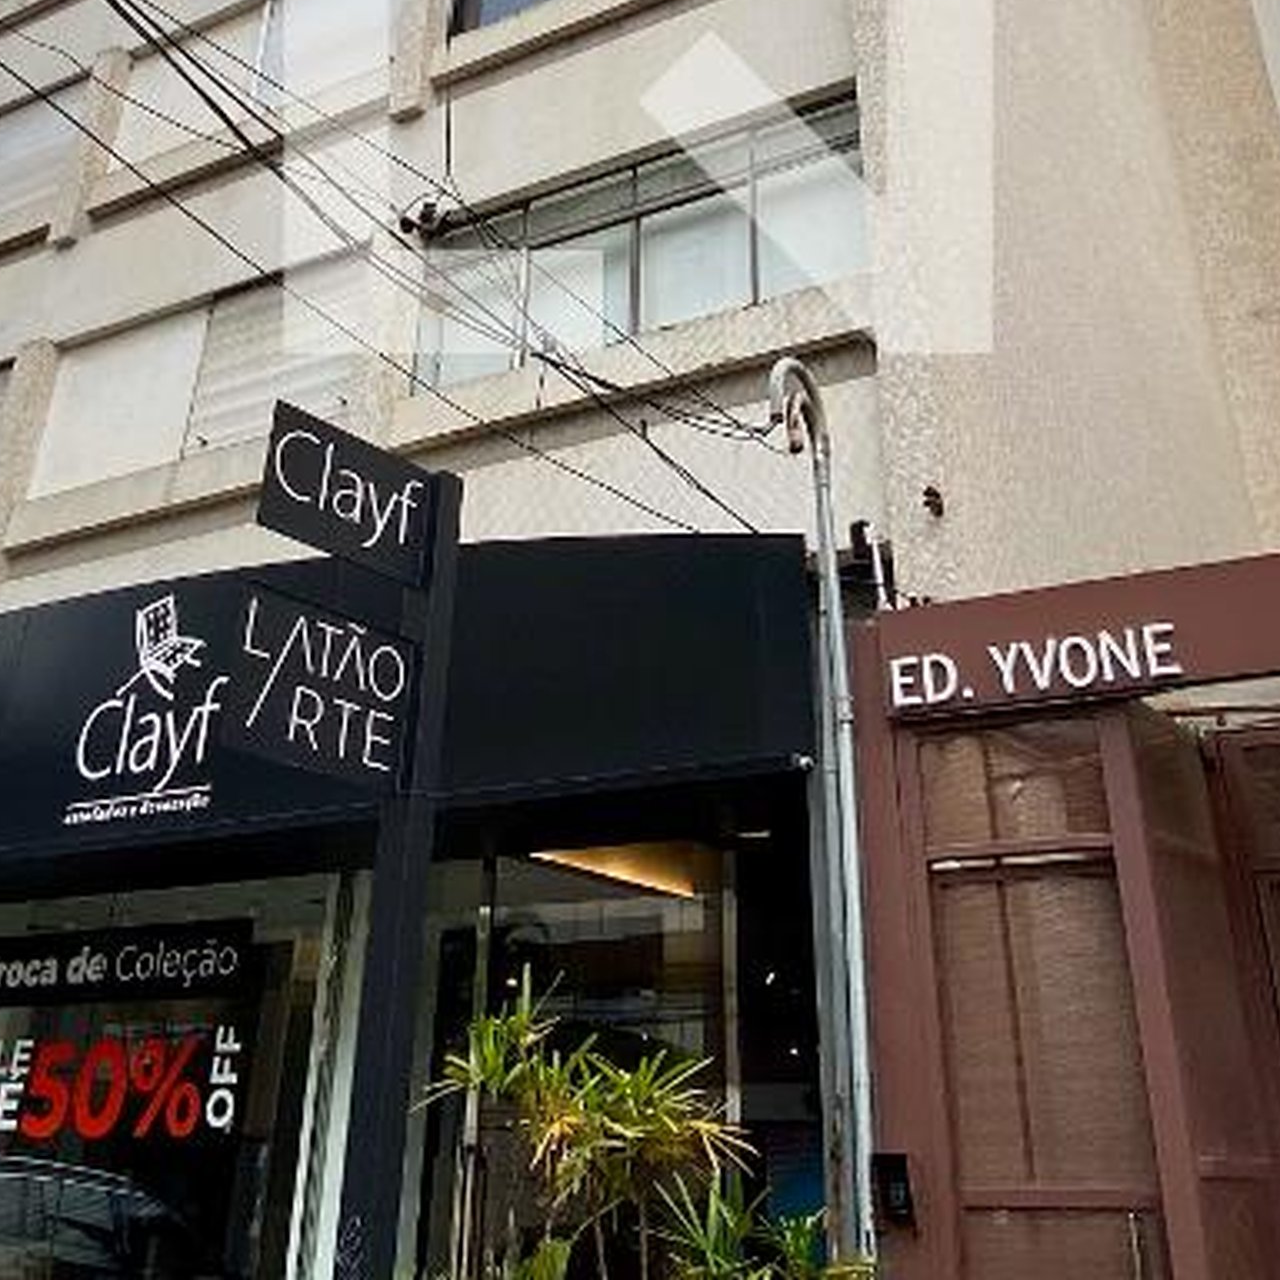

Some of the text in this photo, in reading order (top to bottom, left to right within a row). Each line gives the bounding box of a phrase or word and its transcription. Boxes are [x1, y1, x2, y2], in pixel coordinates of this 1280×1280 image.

[274, 429, 424, 549] Clayf
[889, 622, 1184, 707] ED. YVONE
[76, 675, 231, 795] Clayf
[66, 945, 108, 985] de
[116, 938, 240, 988] Coleção
[20, 1033, 203, 1141] 50%
[205, 1024, 241, 1129] OFF
